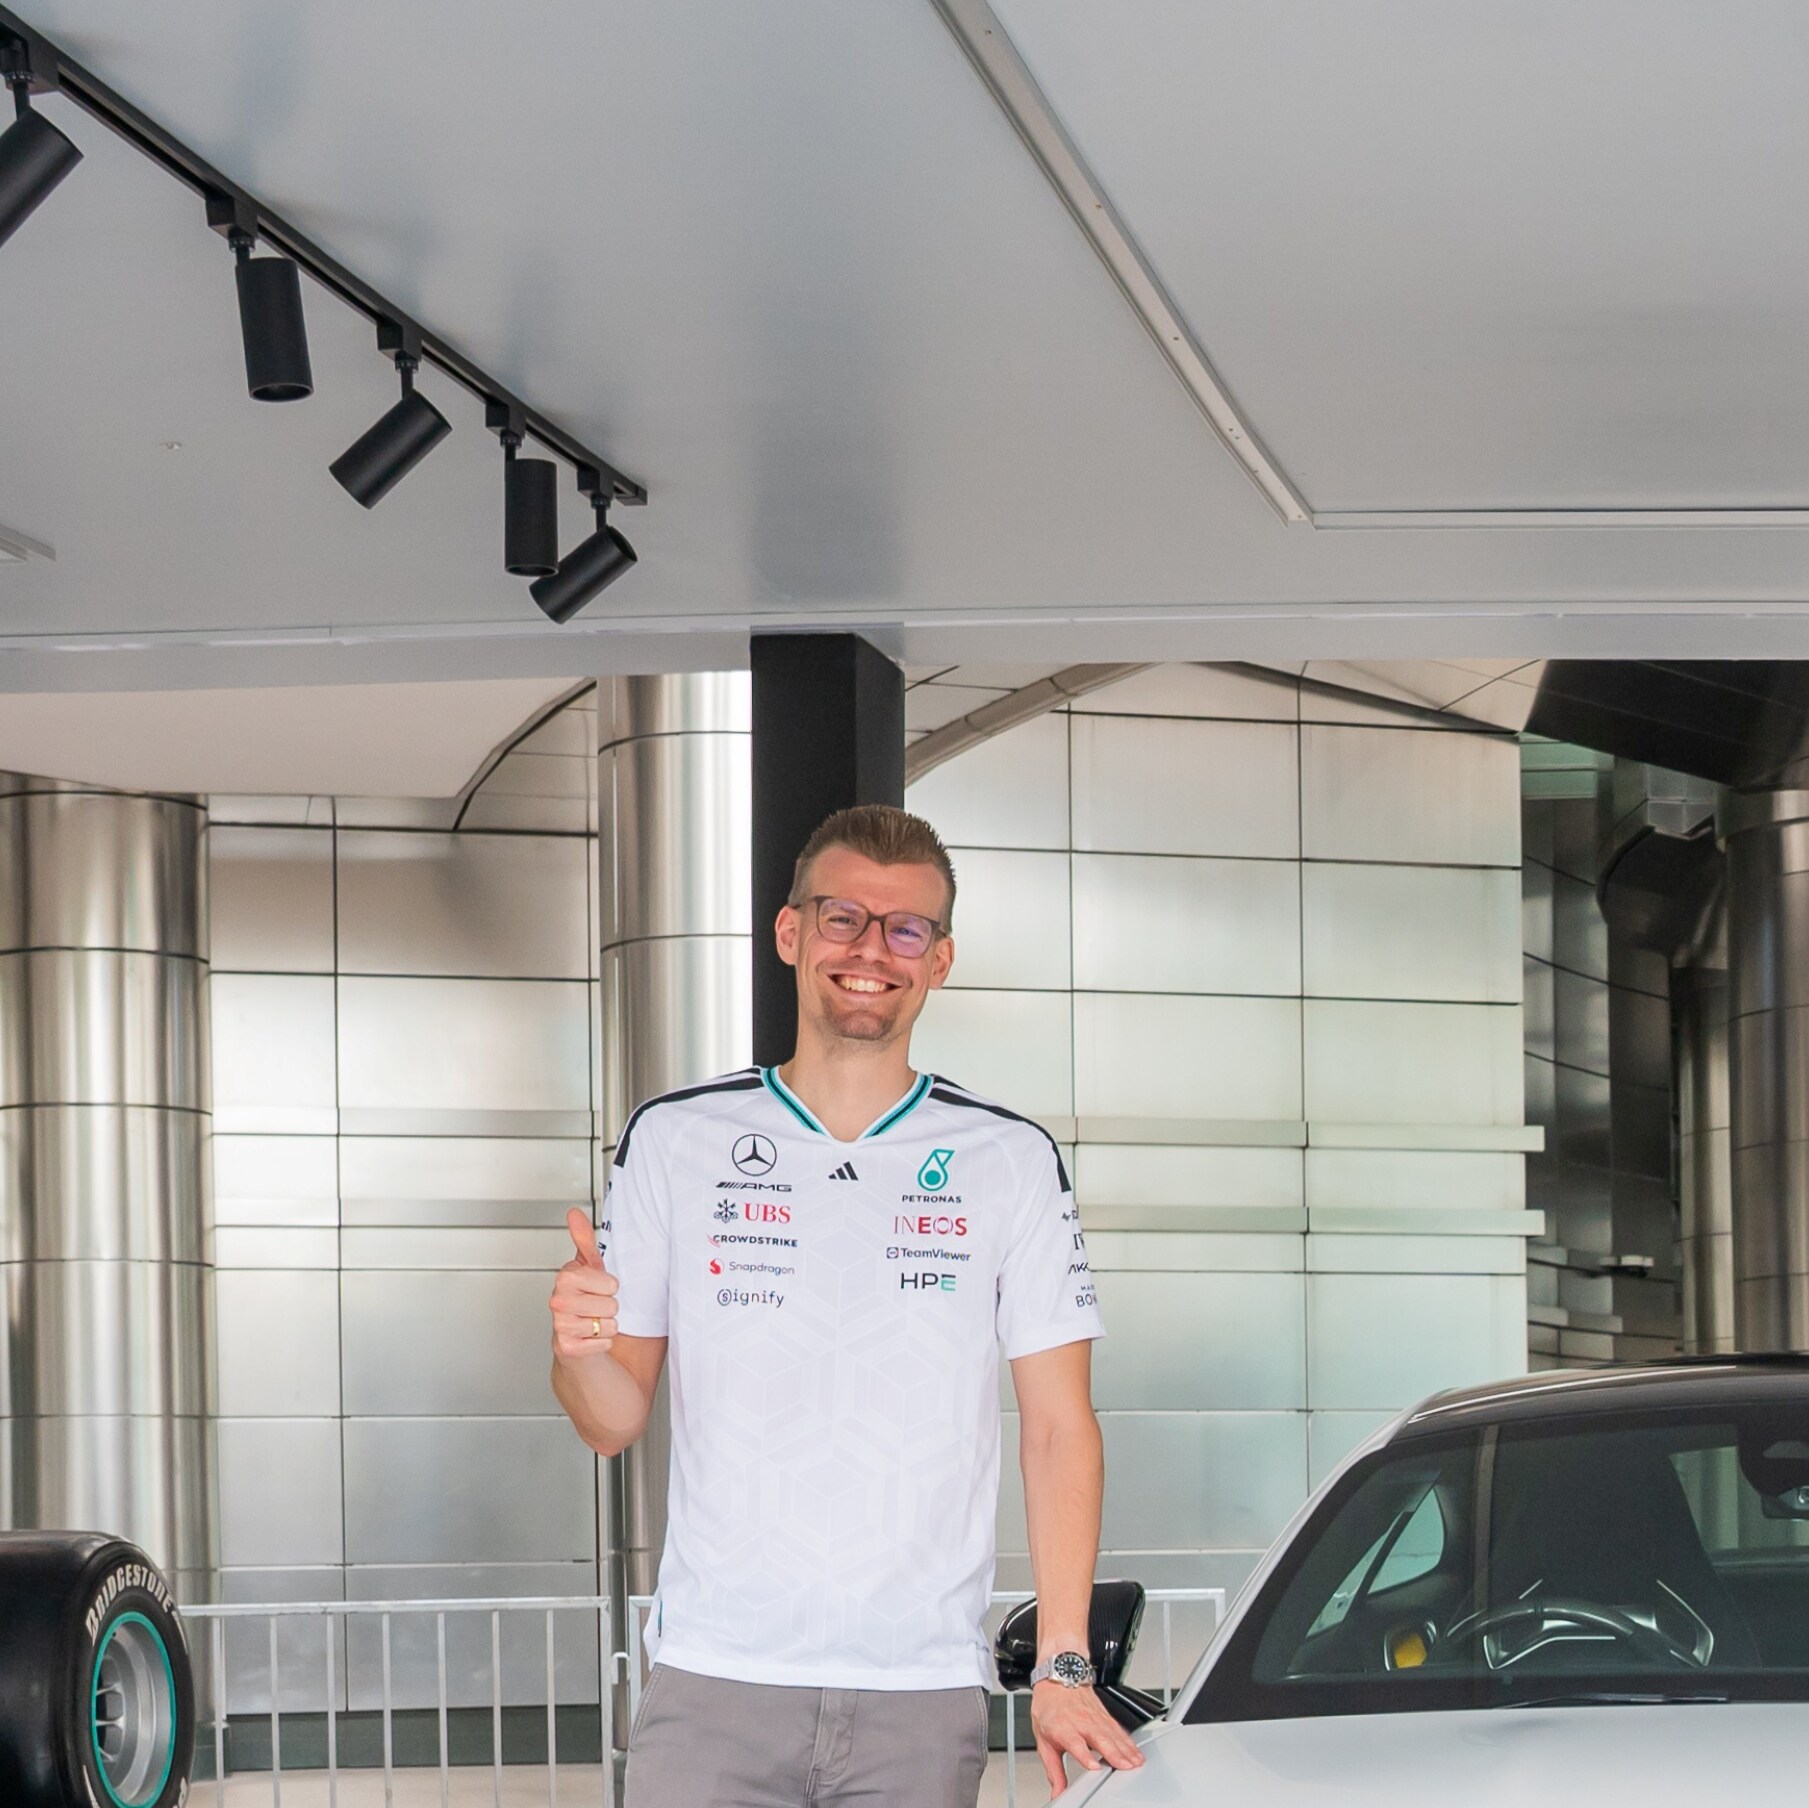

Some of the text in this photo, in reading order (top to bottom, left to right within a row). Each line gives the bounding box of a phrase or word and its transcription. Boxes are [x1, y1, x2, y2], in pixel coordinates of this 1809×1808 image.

[740, 1182, 792, 1192] AMG
[902, 1194, 962, 1203] PETRONAS
[744, 1202, 791, 1224] UBS
[894, 1215, 967, 1236] INEOS
[712, 1234, 798, 1247] CROWDSTRIKE
[901, 1247, 971, 1261] TeamViewer
[729, 1261, 795, 1276] Snapdragon
[900, 1272, 956, 1291] HPE
[85, 1564, 175, 1647] BRIDGESTONE
